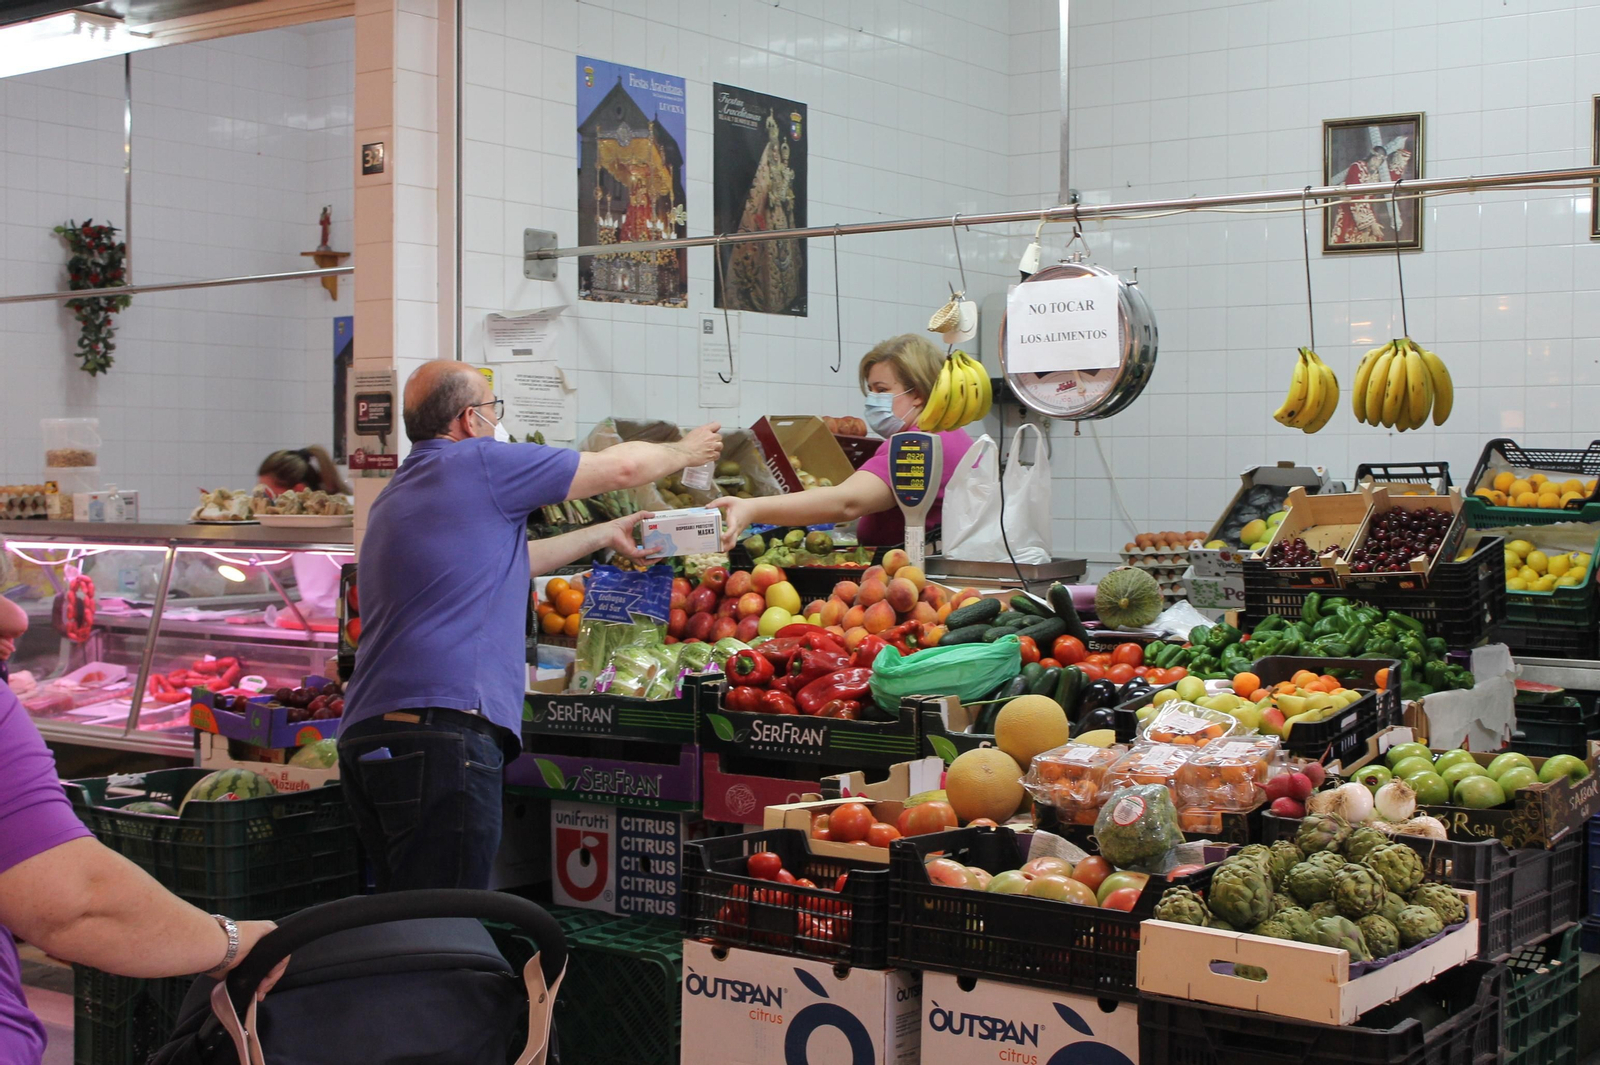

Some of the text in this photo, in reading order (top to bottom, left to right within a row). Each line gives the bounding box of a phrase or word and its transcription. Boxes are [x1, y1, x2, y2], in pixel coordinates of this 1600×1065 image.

[364, 149, 381, 168] 32
[1028, 299, 1095, 316] NO TOCAR
[1020, 329, 1108, 345] LOS ALIMENTOS
[359, 402, 368, 416] P
[698, 528, 715, 536] MASKS
[579, 675, 588, 689] 2
[271, 778, 310, 792] Mozuelo
[281, 772, 288, 781] El
[555, 810, 609, 829] unifrutti
[621, 816, 676, 836] CITRUS
[1473, 824, 1496, 839] Gold
[621, 836, 676, 856] CITRUS
[621, 876, 676, 896] CITRUS
[621, 895, 676, 916] CITRUS
[749, 1008, 783, 1025] citrus
[999, 1048, 1038, 1065] citrus
